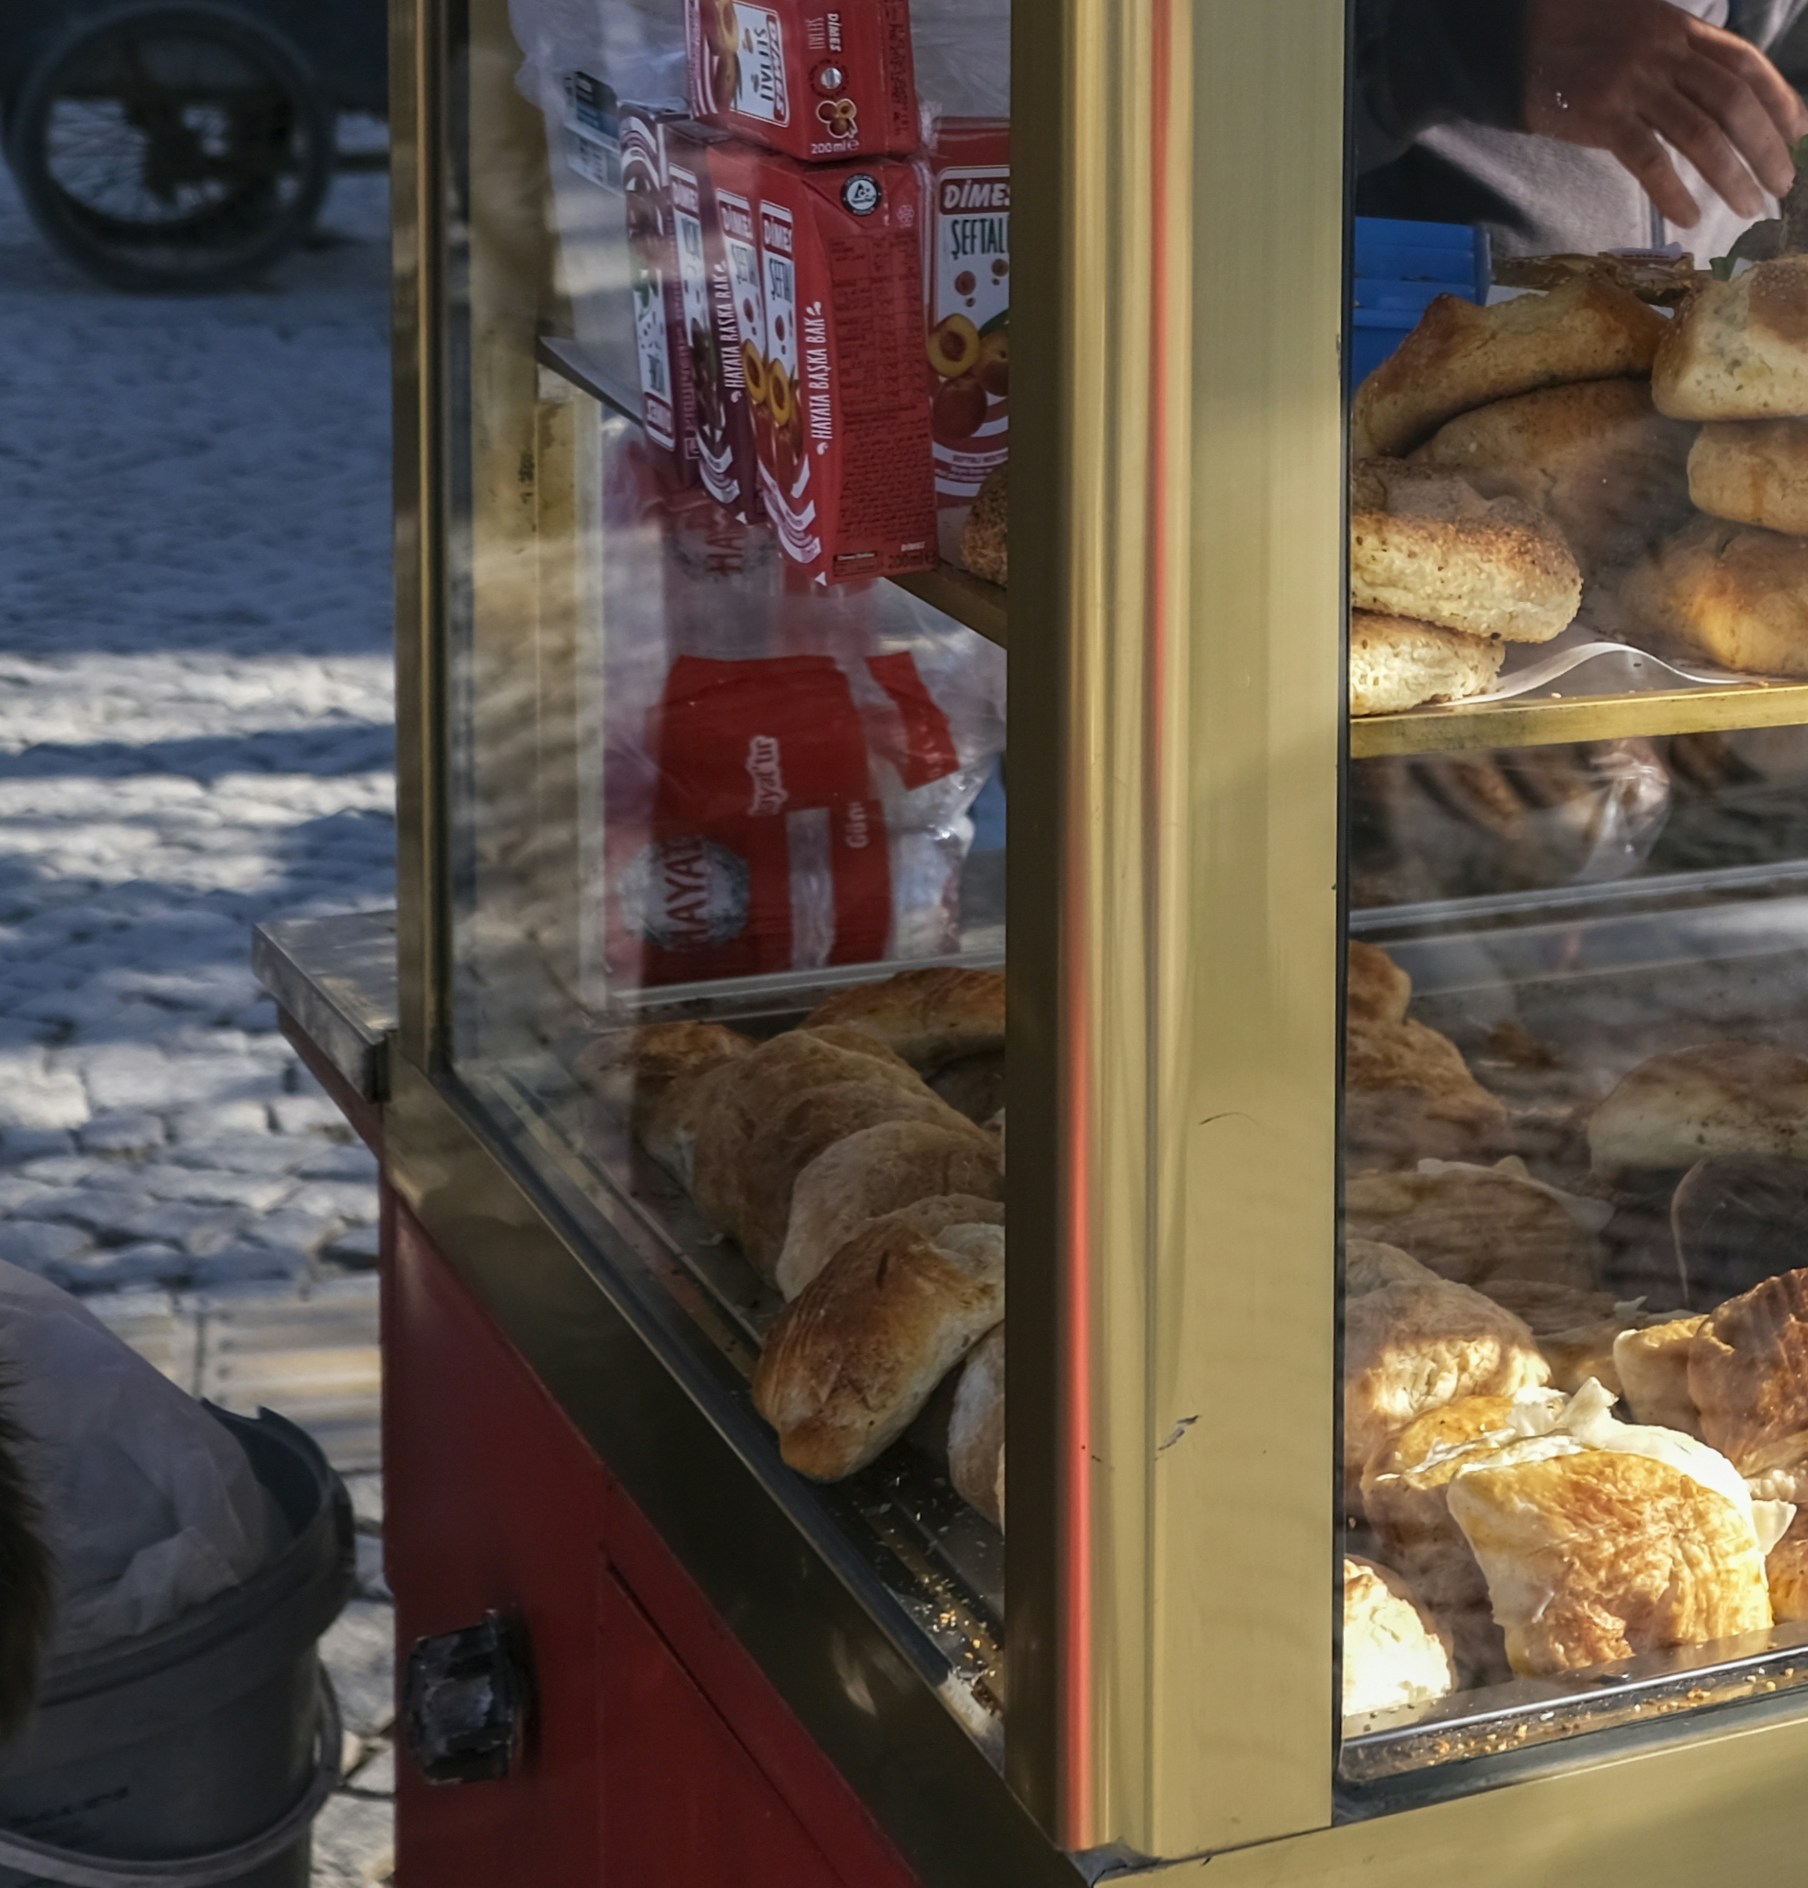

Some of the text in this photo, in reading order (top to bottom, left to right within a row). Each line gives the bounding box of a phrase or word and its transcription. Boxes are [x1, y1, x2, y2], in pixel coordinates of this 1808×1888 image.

[826, 12, 843, 53] DİMES
[804, 313, 834, 441] HAYATA BAŞKA BAK
